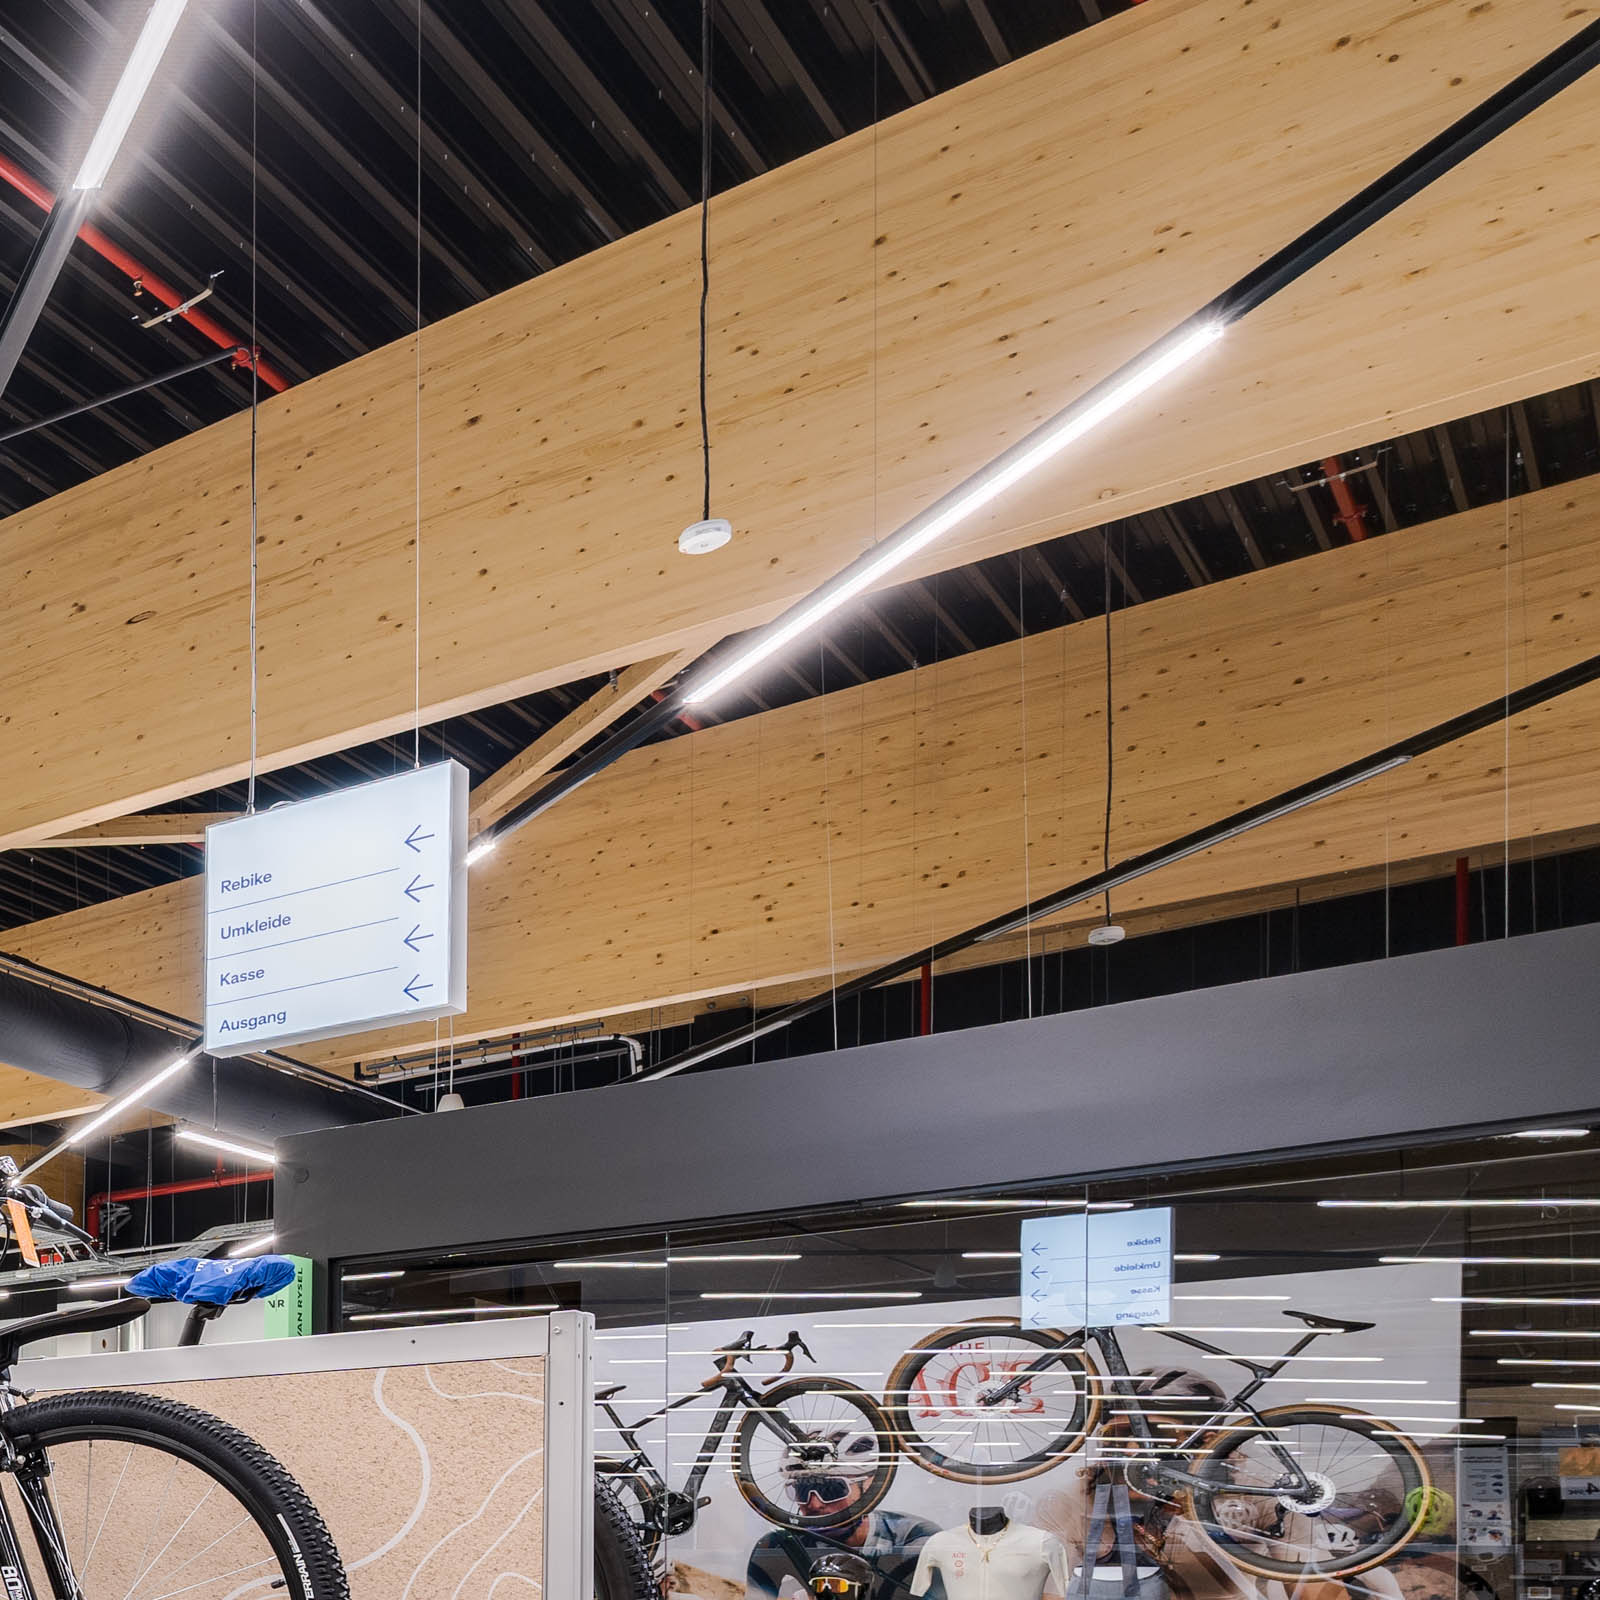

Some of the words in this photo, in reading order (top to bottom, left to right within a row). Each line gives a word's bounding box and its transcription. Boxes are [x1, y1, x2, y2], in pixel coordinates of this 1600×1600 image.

[221, 871, 272, 894] Rebike
[220, 913, 291, 940] Umkleide
[220, 967, 265, 986] Kasse
[219, 1009, 287, 1032] Ausgang
